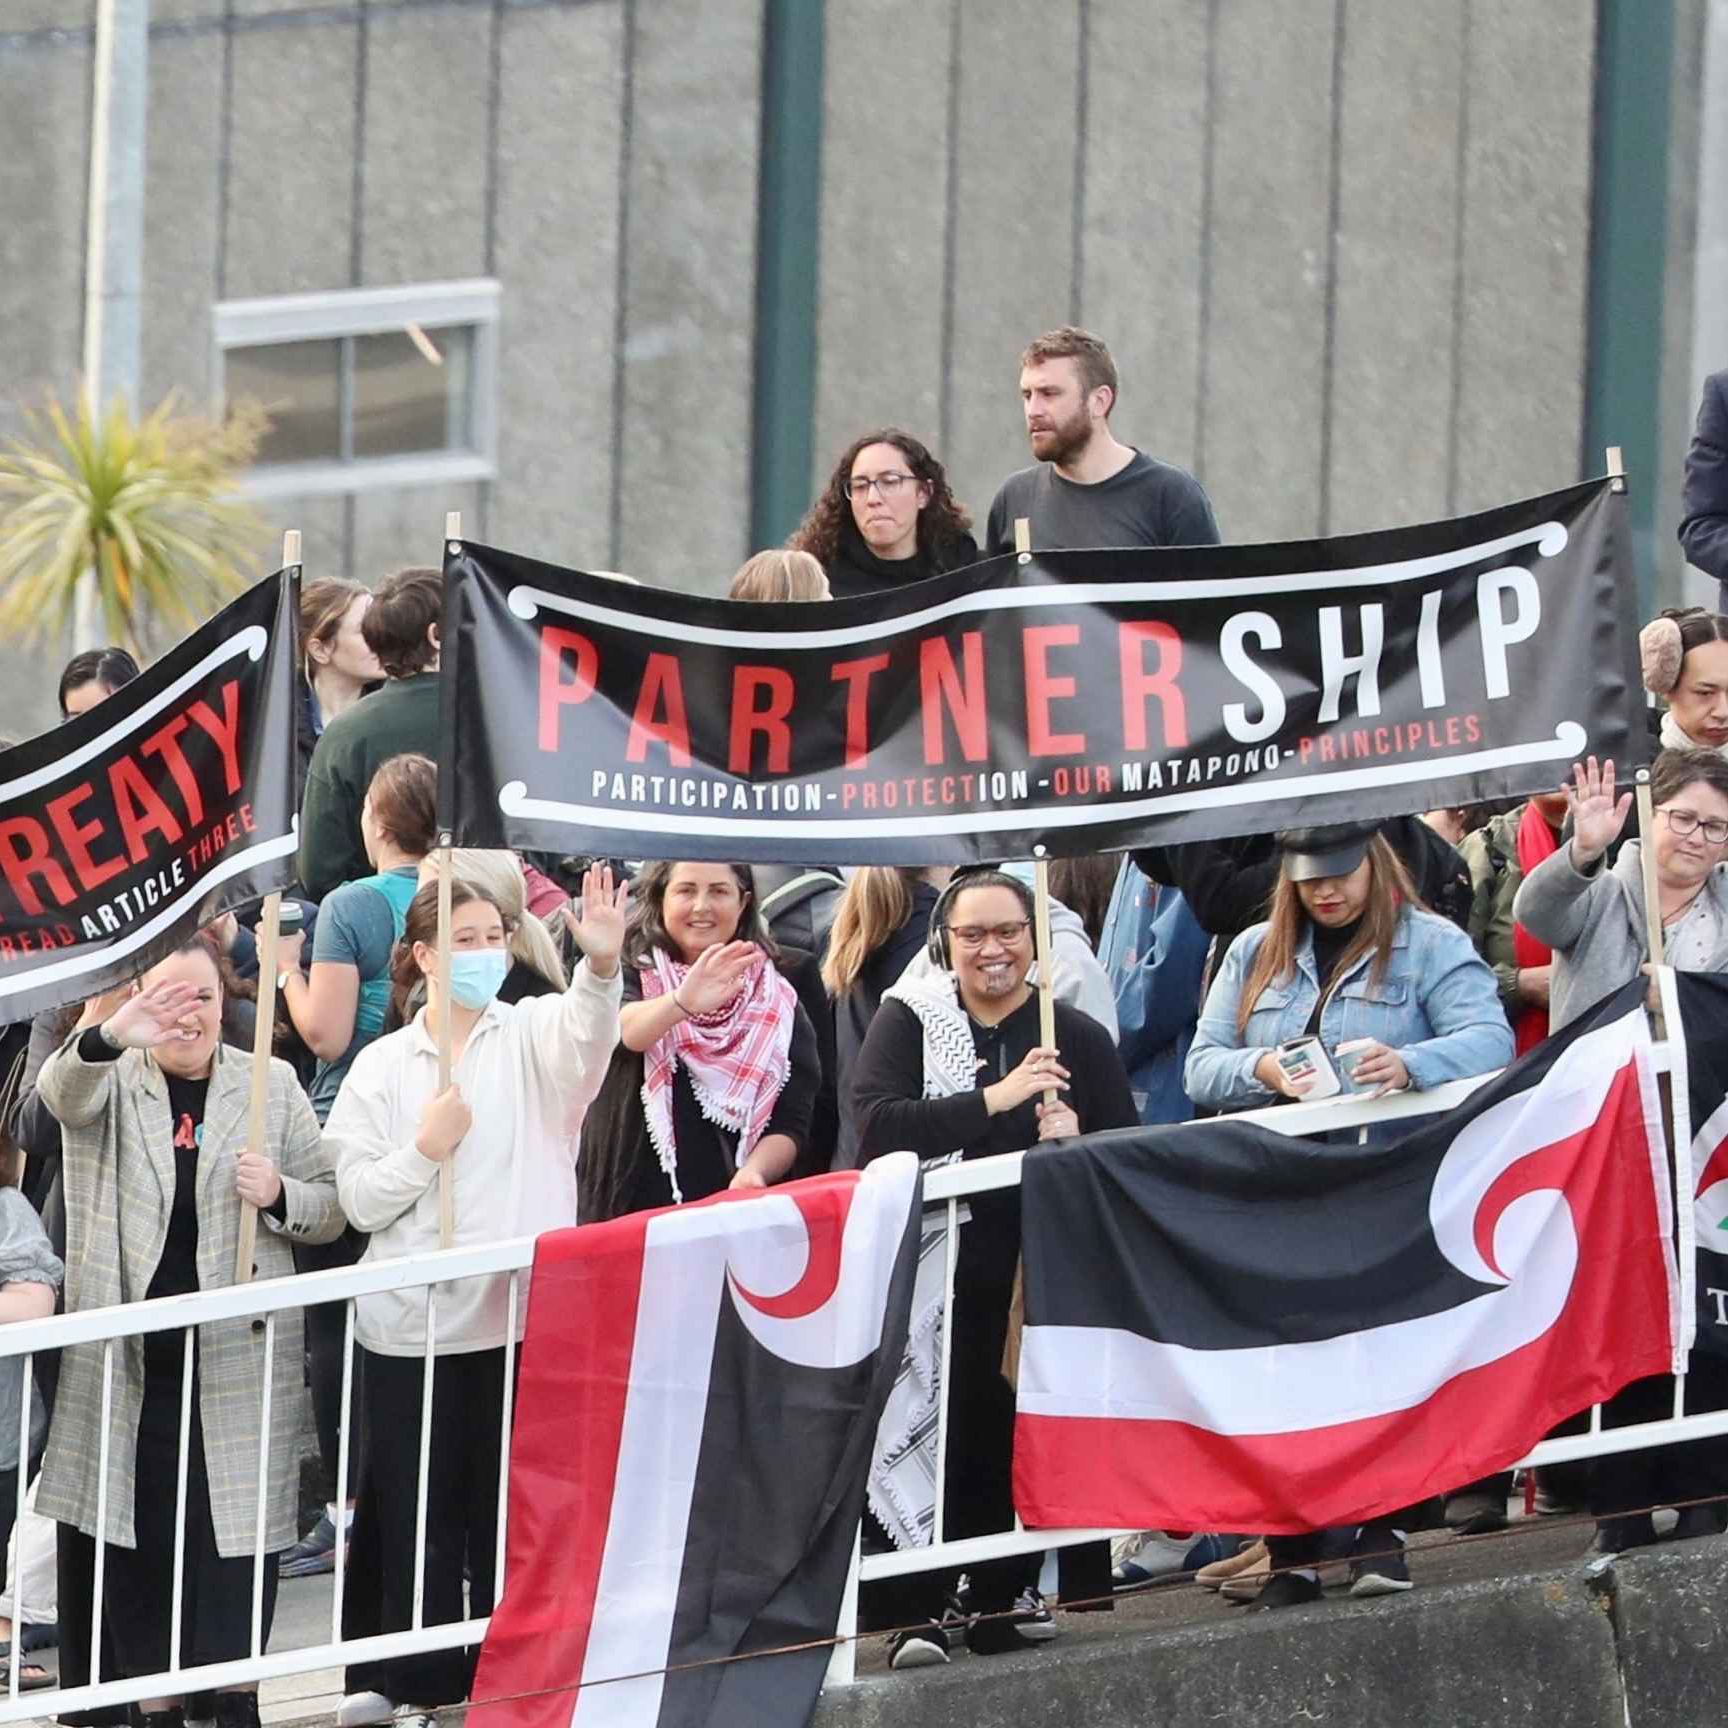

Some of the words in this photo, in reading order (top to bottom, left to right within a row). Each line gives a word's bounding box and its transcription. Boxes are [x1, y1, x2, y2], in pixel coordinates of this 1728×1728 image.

[537, 564, 1543, 774] PARTNERSHIP
[0, 921, 76, 964] READ
[79, 856, 186, 940] ARTICLE
[187, 802, 259, 872] THREE
